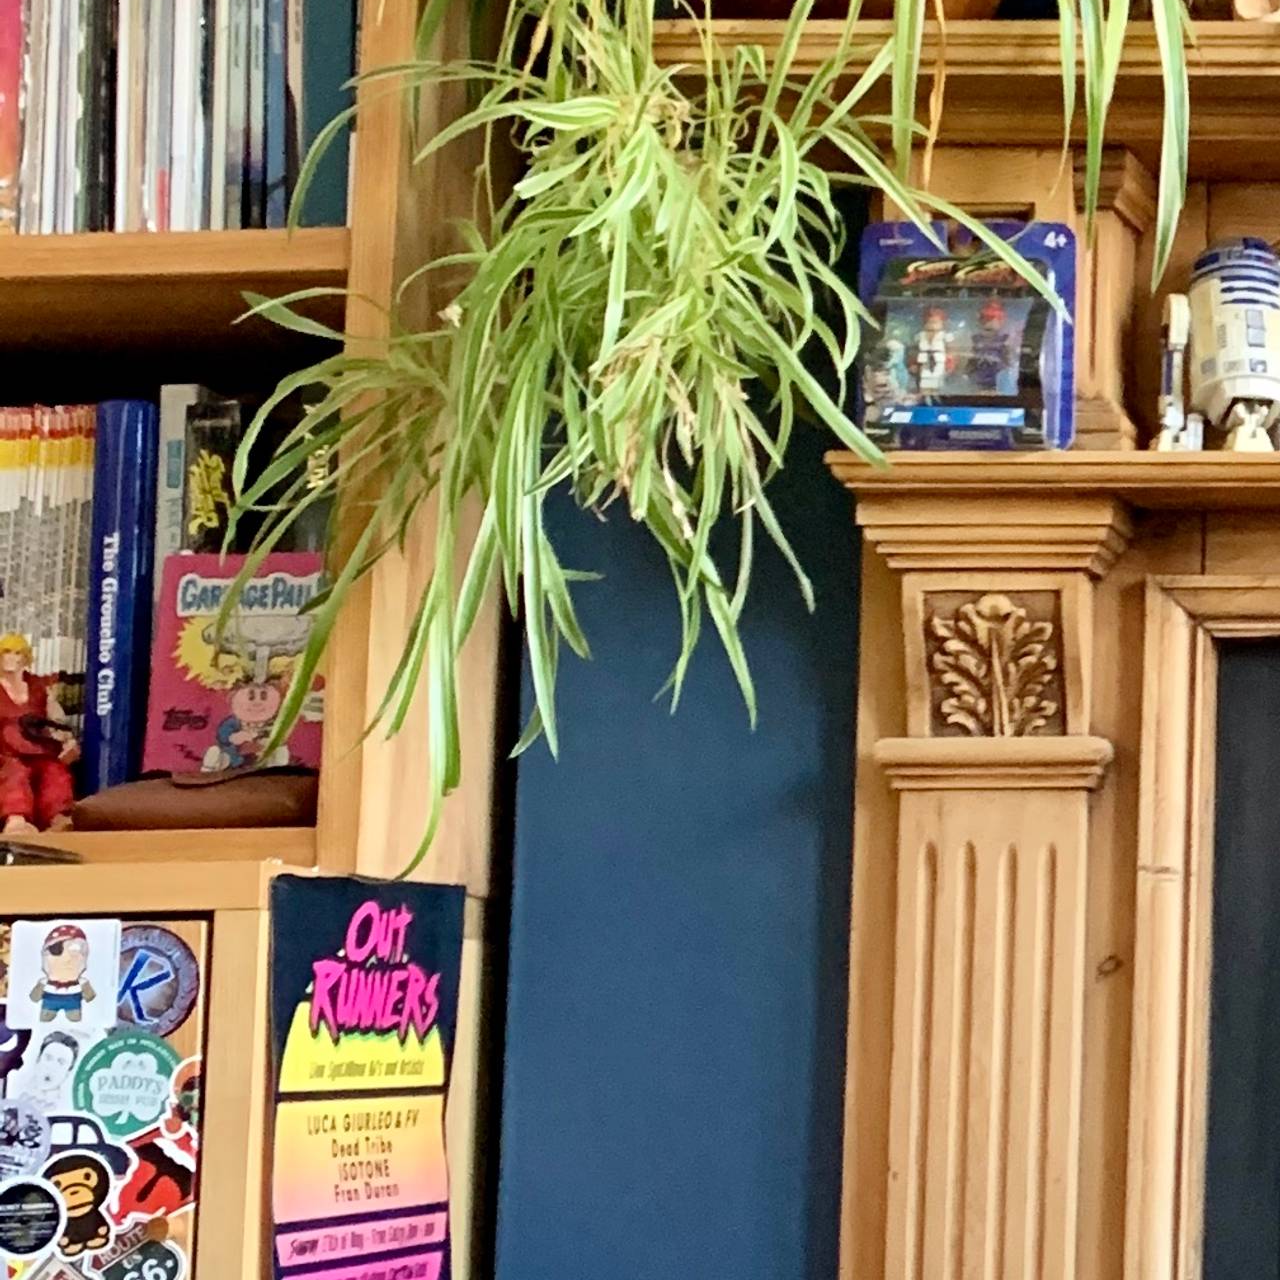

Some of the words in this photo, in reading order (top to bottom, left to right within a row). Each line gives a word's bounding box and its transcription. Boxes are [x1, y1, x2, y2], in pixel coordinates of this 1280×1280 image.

[102, 531, 120, 572] The
[180, 577, 269, 612] GARAGE
[98, 577, 119, 665] Groucho
[96, 669, 116, 717] Club
[309, 959, 442, 1047] RUNNERS
[307, 1114, 337, 1135] LUCA
[343, 1111, 393, 1133] GIURLEO
[394, 1111, 402, 1129] &
[331, 1137, 360, 1158] Dead
[364, 1135, 393, 1154] Tribe
[338, 1159, 391, 1182] ISOTONE
[333, 1183, 361, 1203] Fran
[100, 1224, 146, 1266] ROUTE
[121, 1250, 143, 1270] US
